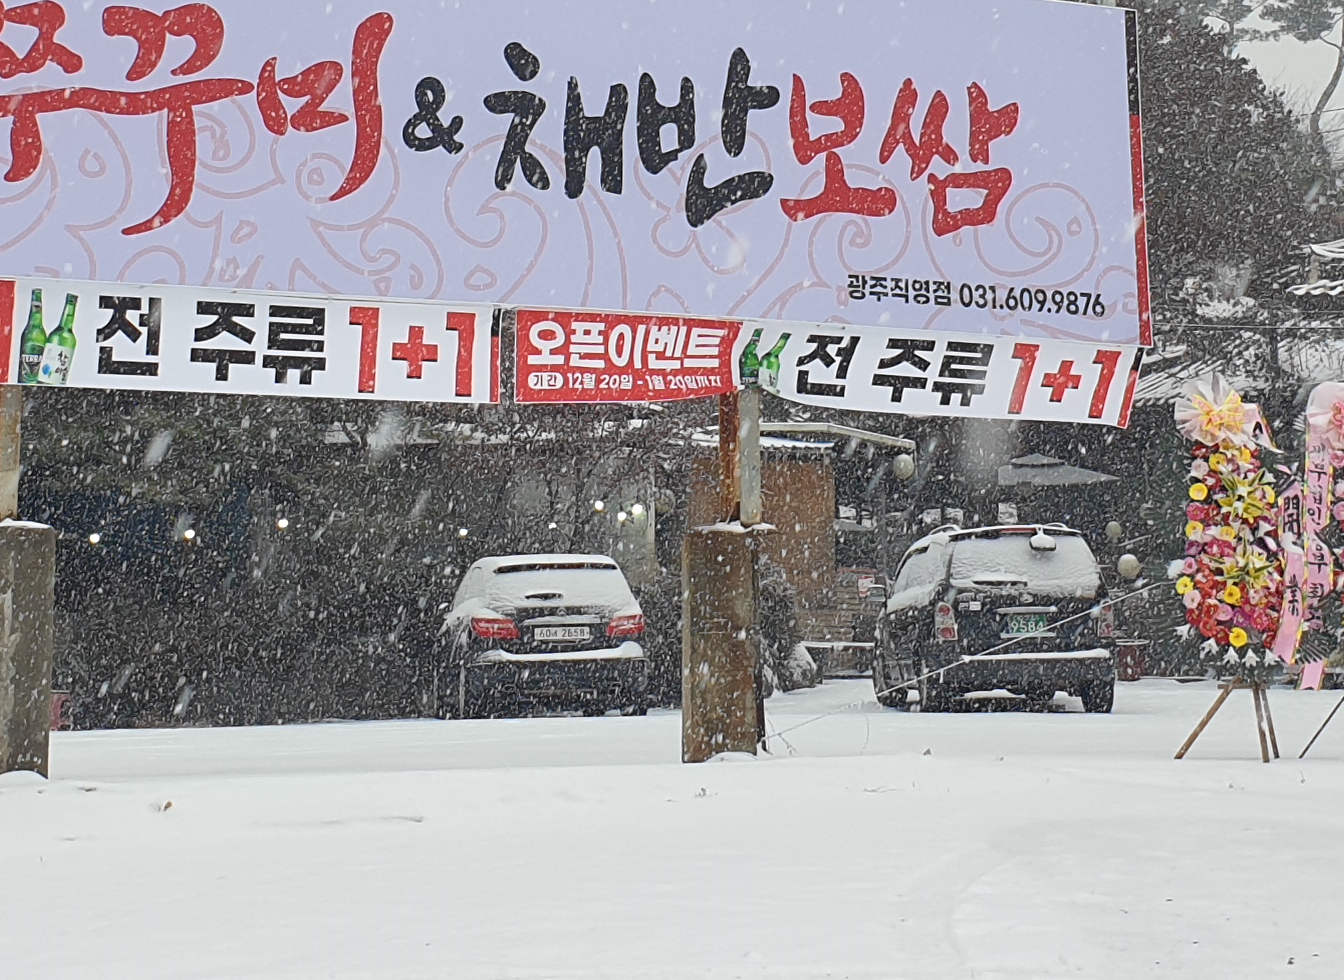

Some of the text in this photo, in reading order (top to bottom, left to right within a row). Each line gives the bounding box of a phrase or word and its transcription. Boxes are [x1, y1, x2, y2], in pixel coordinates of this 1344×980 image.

[846, 273, 1106, 317] 광주직영점 031.609.9876
[96, 296, 478, 398] 전 주류 1+1
[527, 320, 726, 370] 오픈이벤트
[533, 374, 558, 388] 기간
[566, 371, 597, 390] 12월
[598, 374, 634, 390] 20일
[644, 376, 666, 390] 1월
[796, 333, 1124, 420] 전 주류 1+1
